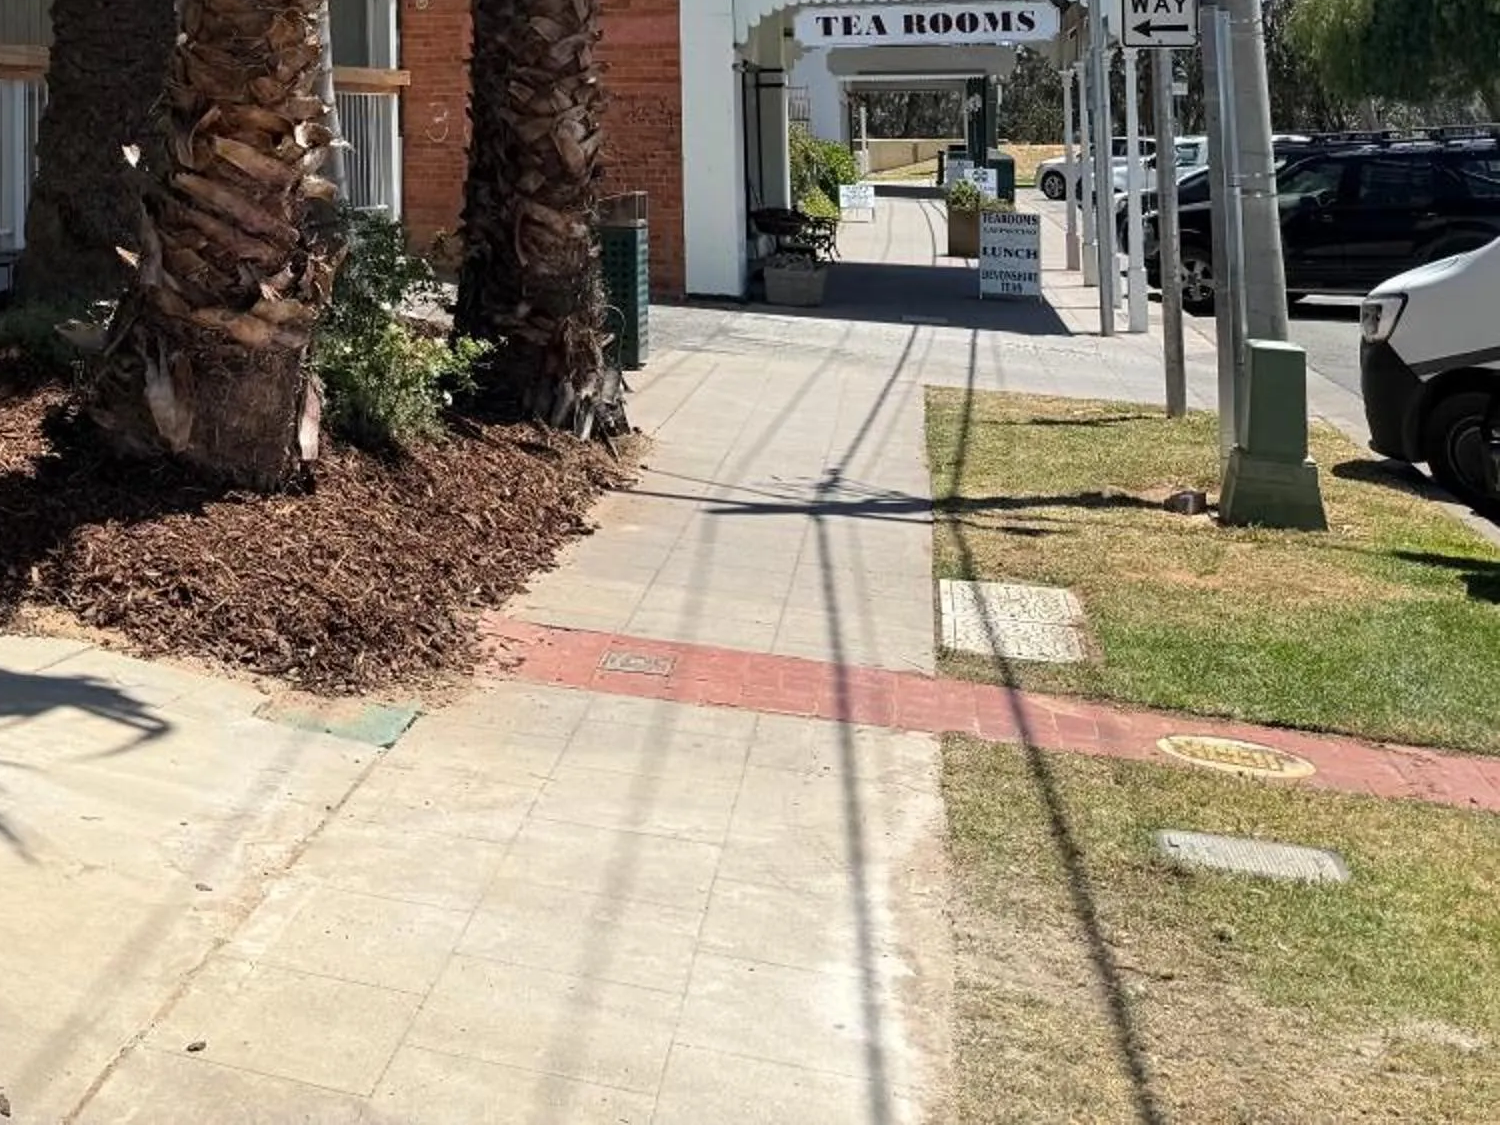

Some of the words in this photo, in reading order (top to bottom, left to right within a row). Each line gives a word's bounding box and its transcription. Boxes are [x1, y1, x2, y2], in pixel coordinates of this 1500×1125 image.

[816, 14, 887, 36] TEA
[903, 10, 1036, 34] ROOMS
[982, 246, 1039, 260] LUNCH
